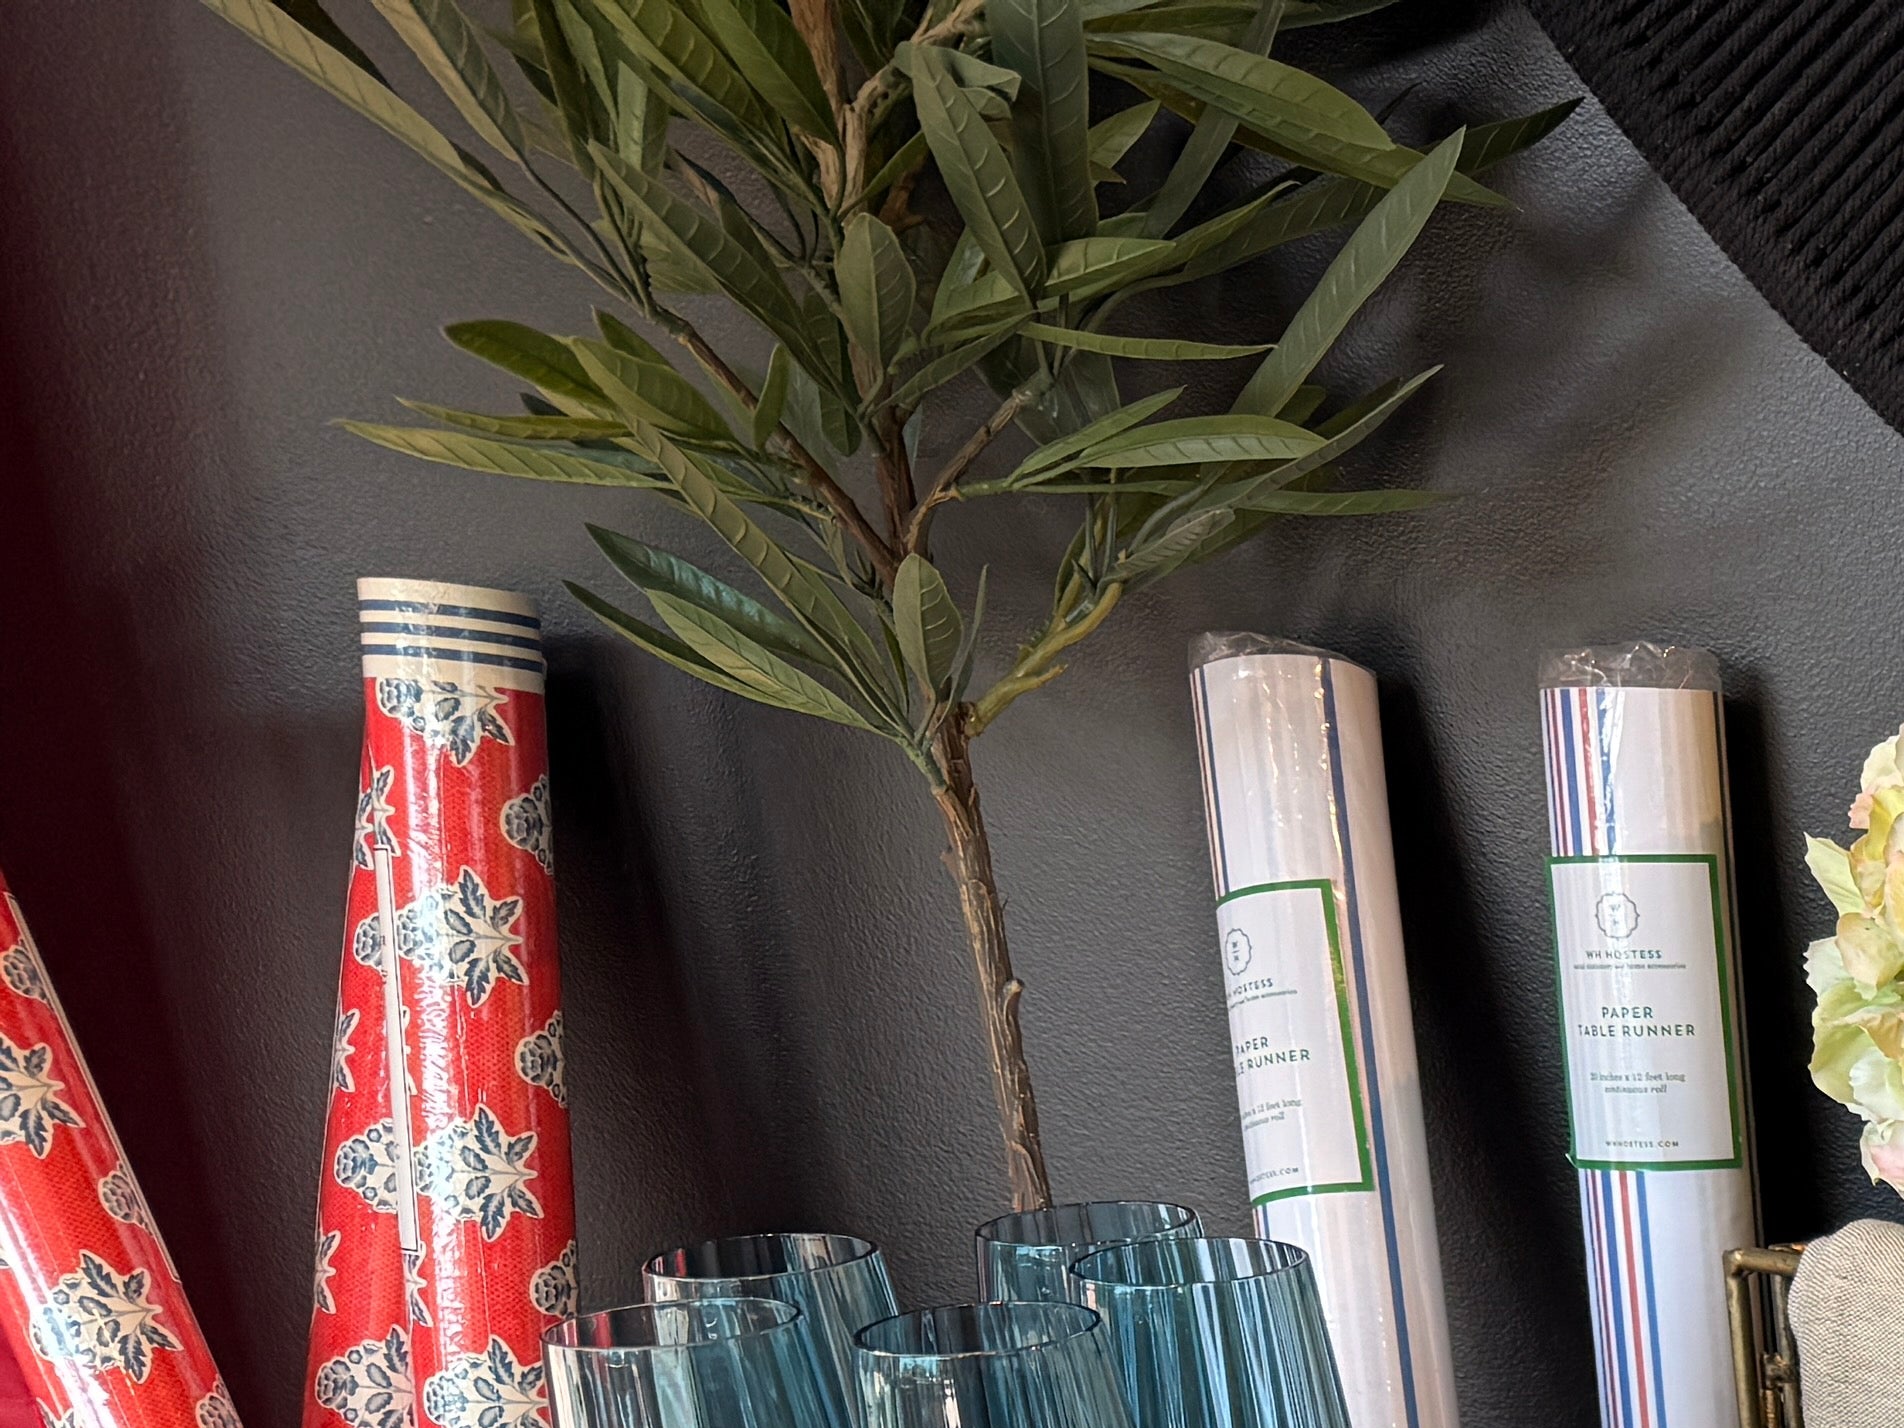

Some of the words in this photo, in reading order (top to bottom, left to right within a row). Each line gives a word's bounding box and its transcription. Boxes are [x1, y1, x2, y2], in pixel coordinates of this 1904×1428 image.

[1602, 1006, 1654, 1019] PAPER
[1578, 1025, 1616, 1037] TABLE
[1622, 1024, 1696, 1037] RUNNER
[1248, 1049, 1311, 1071] RUNNER
